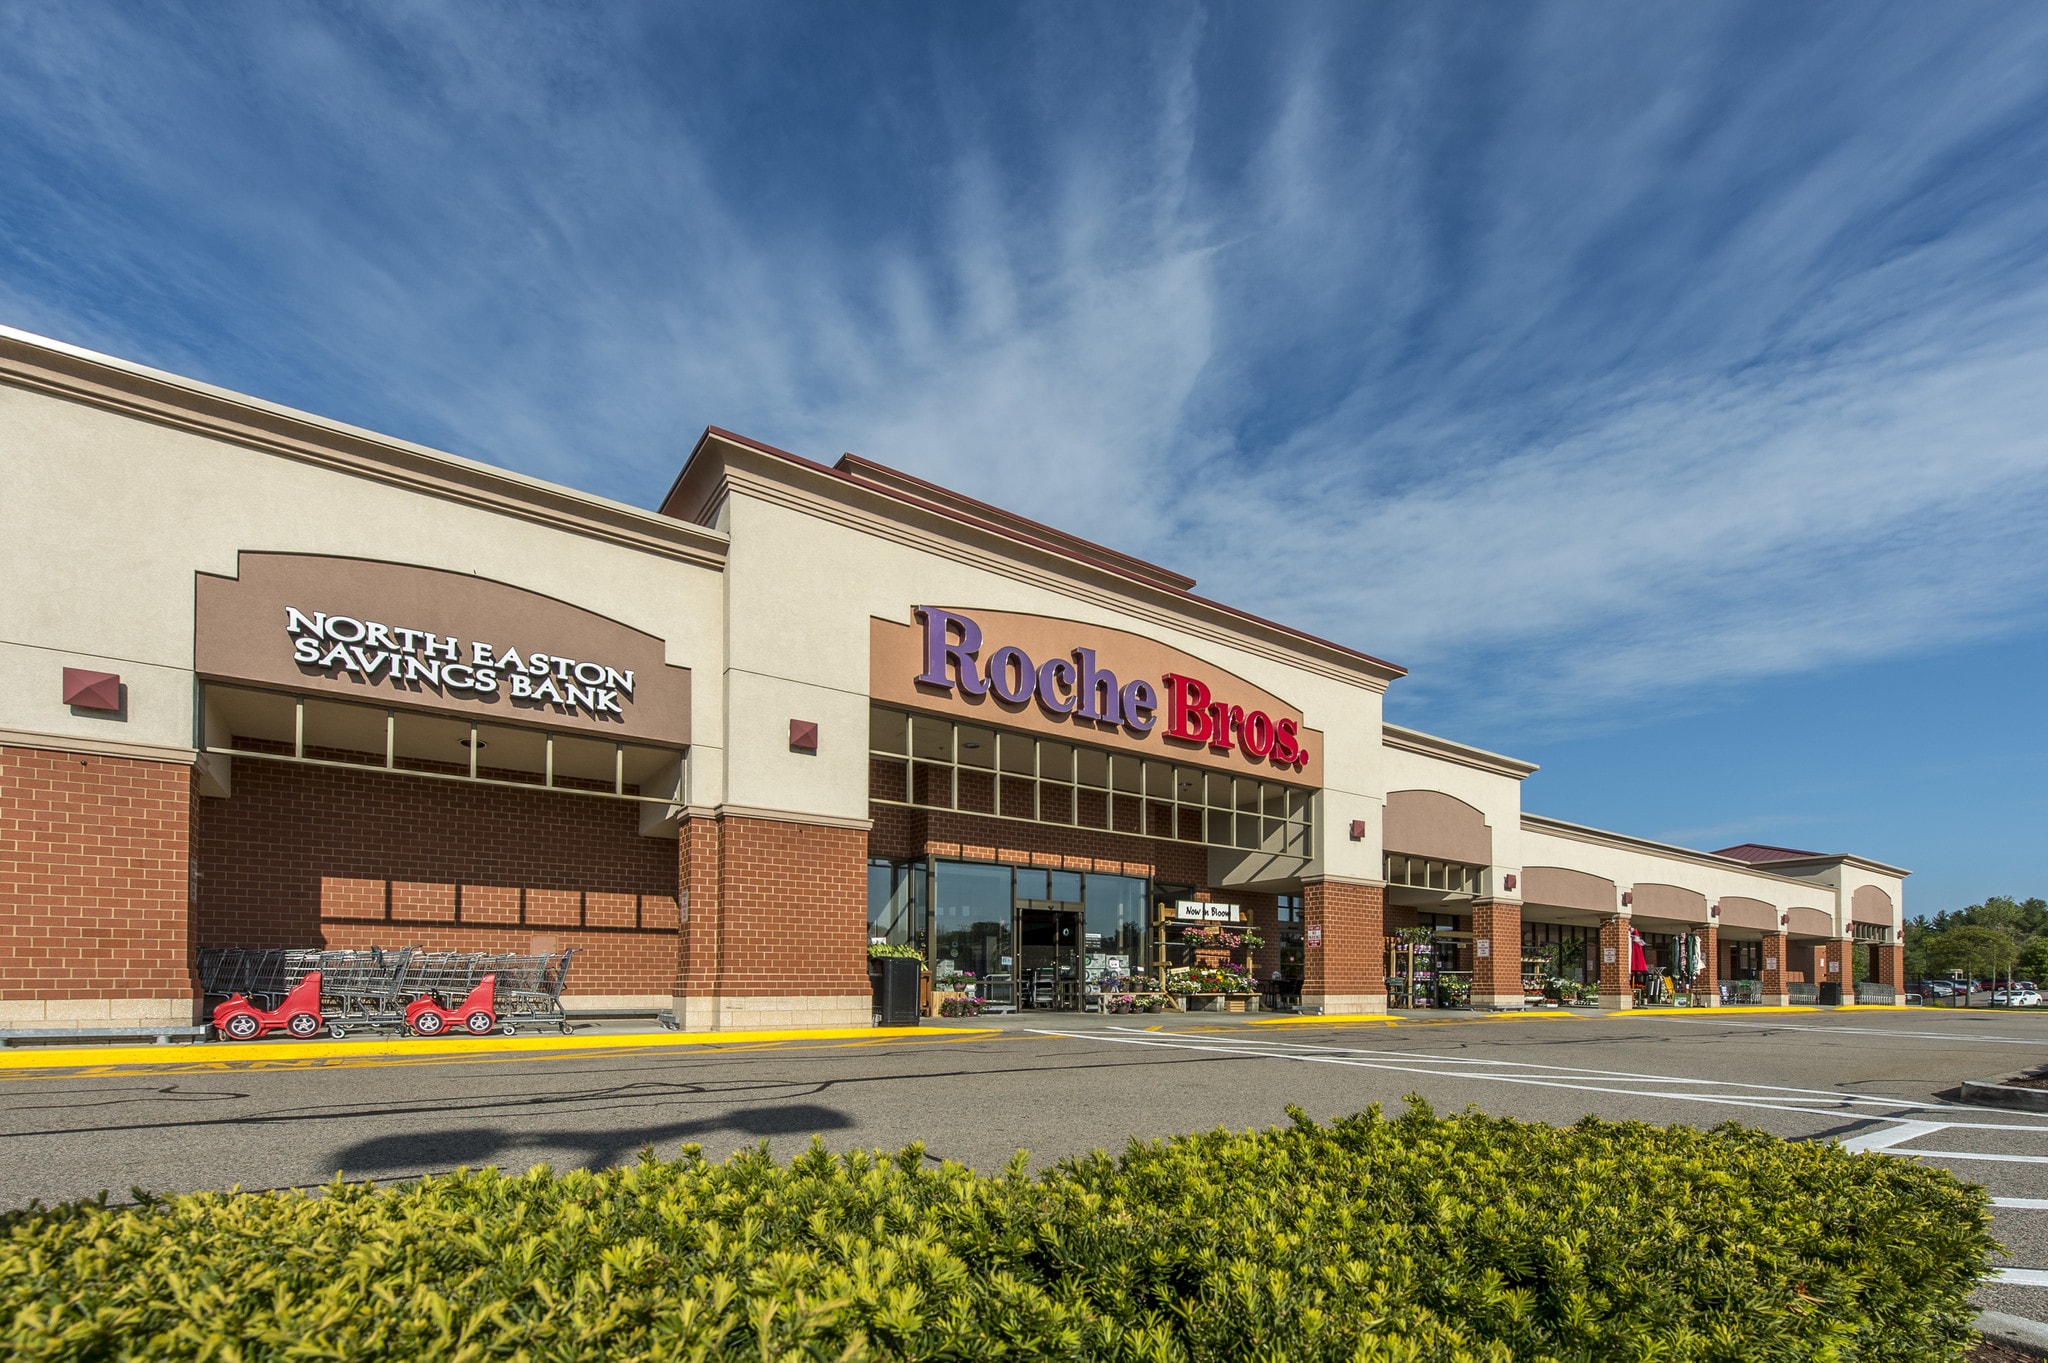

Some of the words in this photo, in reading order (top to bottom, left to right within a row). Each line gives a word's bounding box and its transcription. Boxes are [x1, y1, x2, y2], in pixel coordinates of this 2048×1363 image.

[285, 606, 458, 661] NORTH
[471, 641, 634, 694] EASTON
[294, 637, 497, 692] SAVINGS
[510, 673, 623, 714] BANK
[913, 604, 1158, 732] Roche
[1161, 672, 1310, 766] Bros.
[1185, 906, 1202, 916] Now
